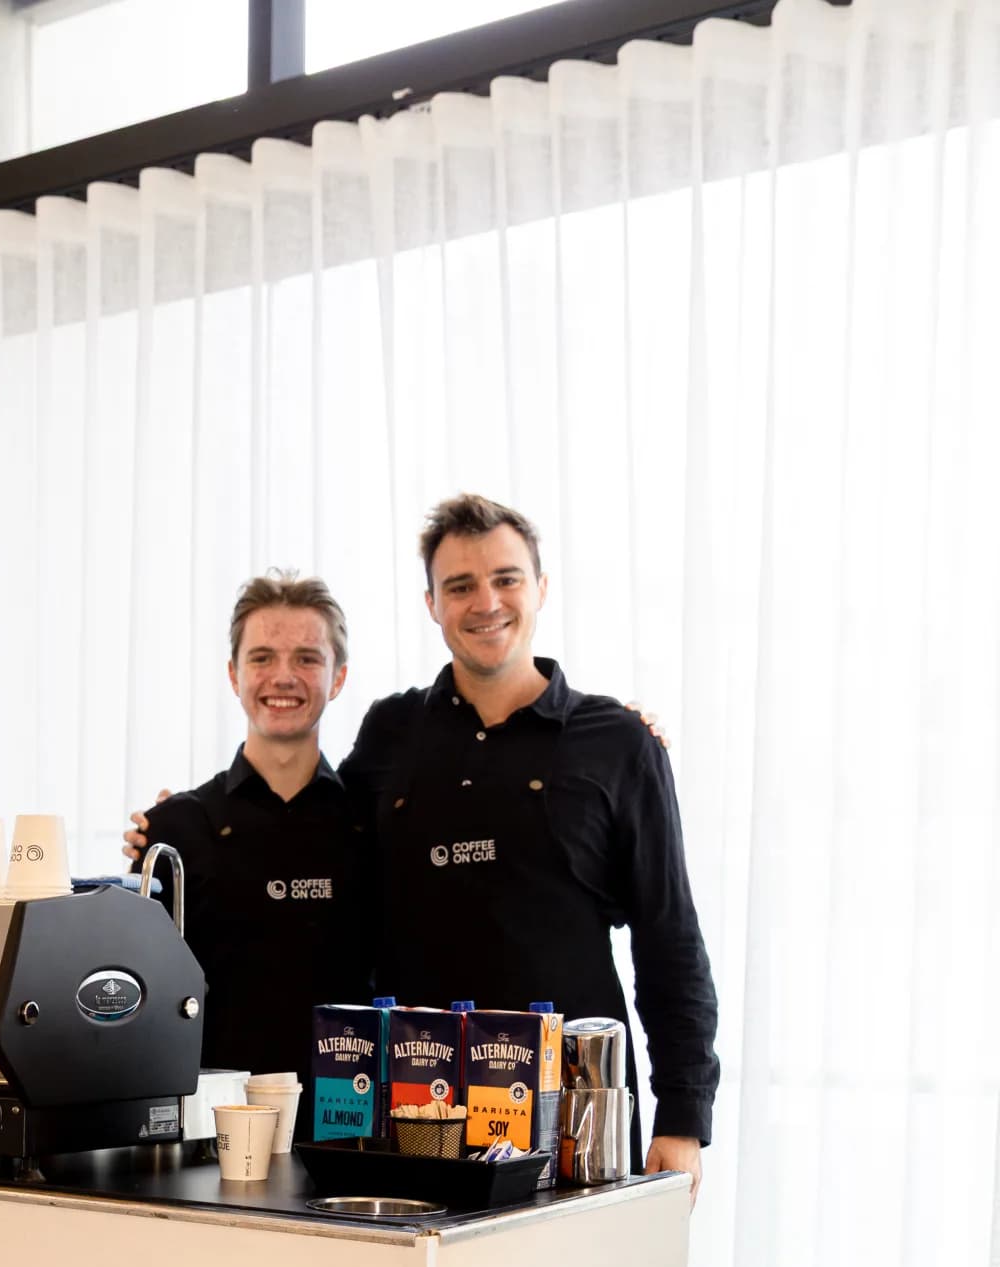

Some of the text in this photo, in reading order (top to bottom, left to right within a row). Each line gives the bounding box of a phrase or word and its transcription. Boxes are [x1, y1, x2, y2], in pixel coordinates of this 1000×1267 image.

[452, 839, 496, 854] COFFEE
[452, 850, 496, 864] ON CUE
[290, 878, 332, 890] COFFEE
[290, 888, 332, 899] ON CUE
[317, 1036, 375, 1057] ALTERNATIVE
[394, 1040, 455, 1062] ALTERNATIVE
[335, 1053, 351, 1062] DAIRY
[470, 1043, 534, 1065] ALTERNATIVE
[411, 1057, 428, 1066] DAIRY
[488, 1060, 506, 1070] DAIRY
[319, 1096, 369, 1105] BARISTA
[473, 1106, 527, 1116] BARISTA
[322, 1109, 364, 1127] ALMOND
[488, 1120, 509, 1137] SOY
